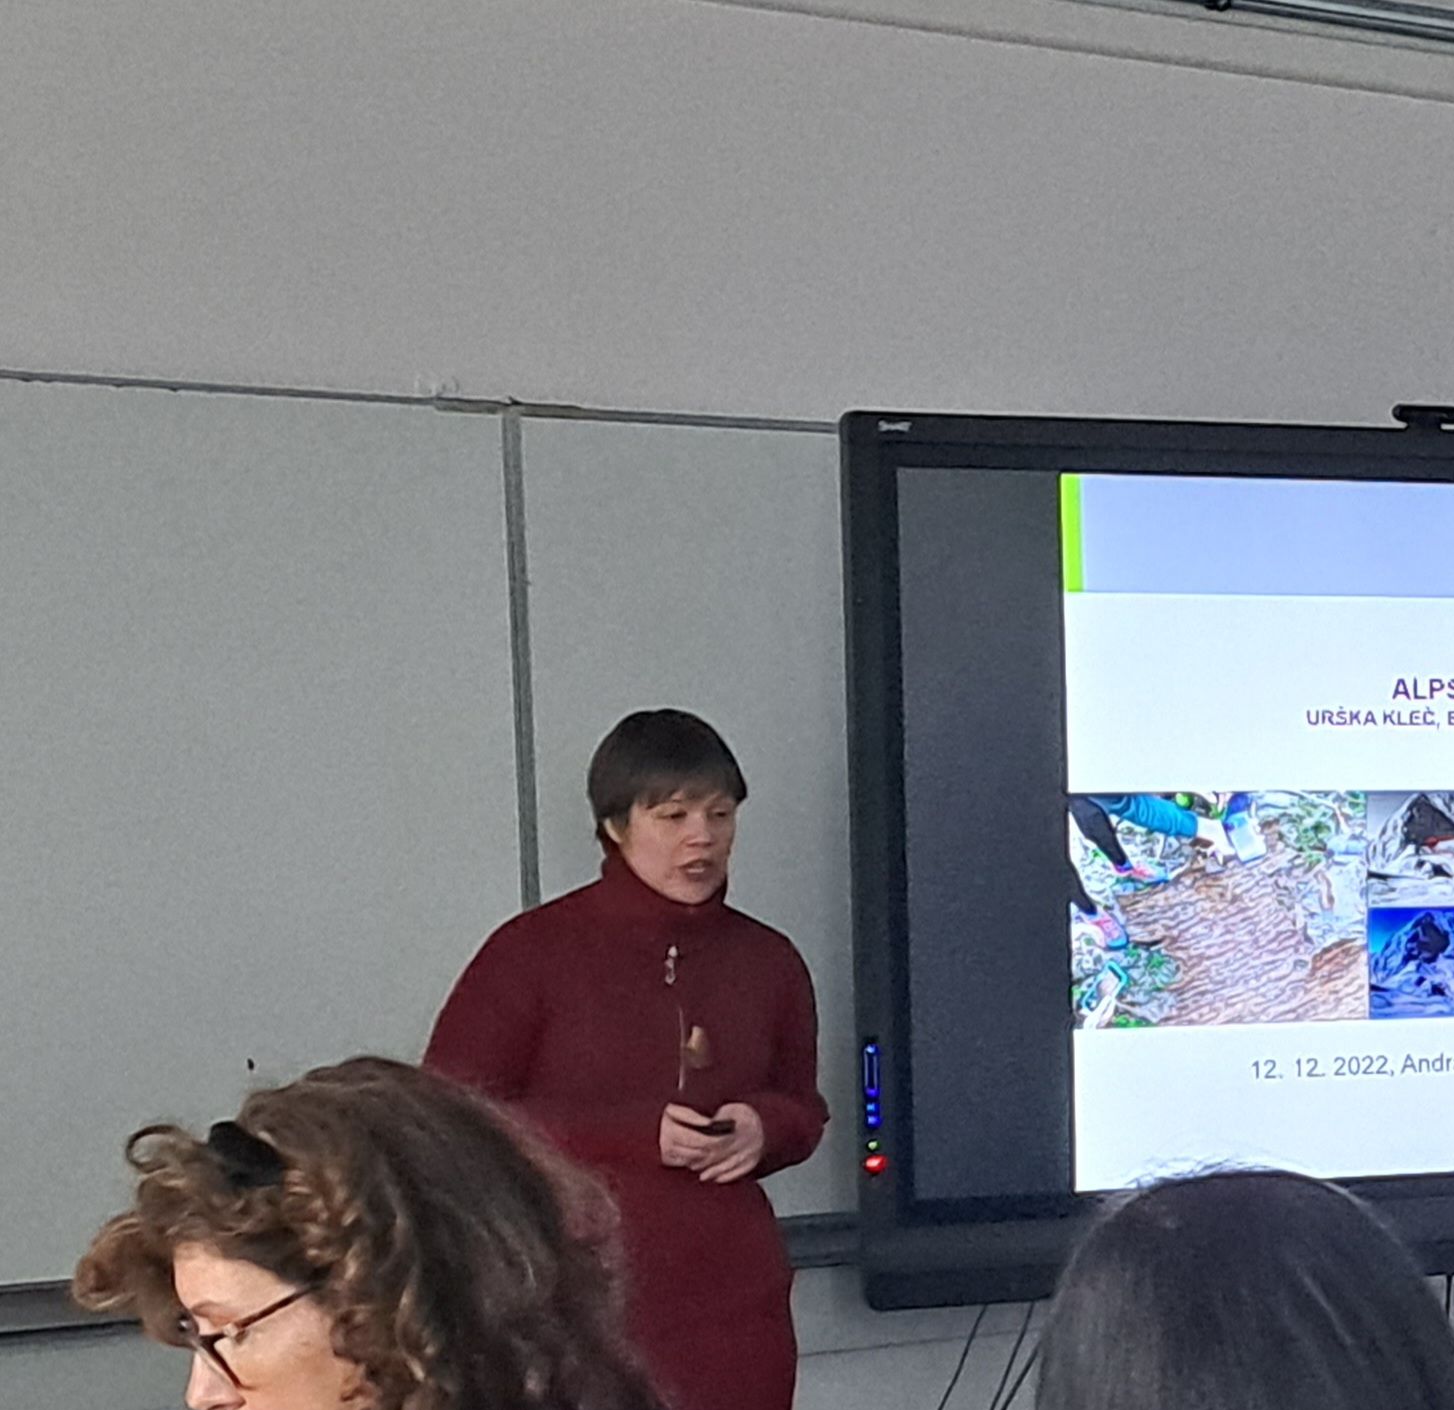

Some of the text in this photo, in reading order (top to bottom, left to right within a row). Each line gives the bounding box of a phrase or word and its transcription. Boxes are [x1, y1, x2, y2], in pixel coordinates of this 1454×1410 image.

[1306, 705, 1378, 727] URŠKA
[1250, 1058, 1284, 1080] 12.
[1295, 1057, 1326, 1079] 12.
[1333, 1054, 1395, 1078] 2022,
